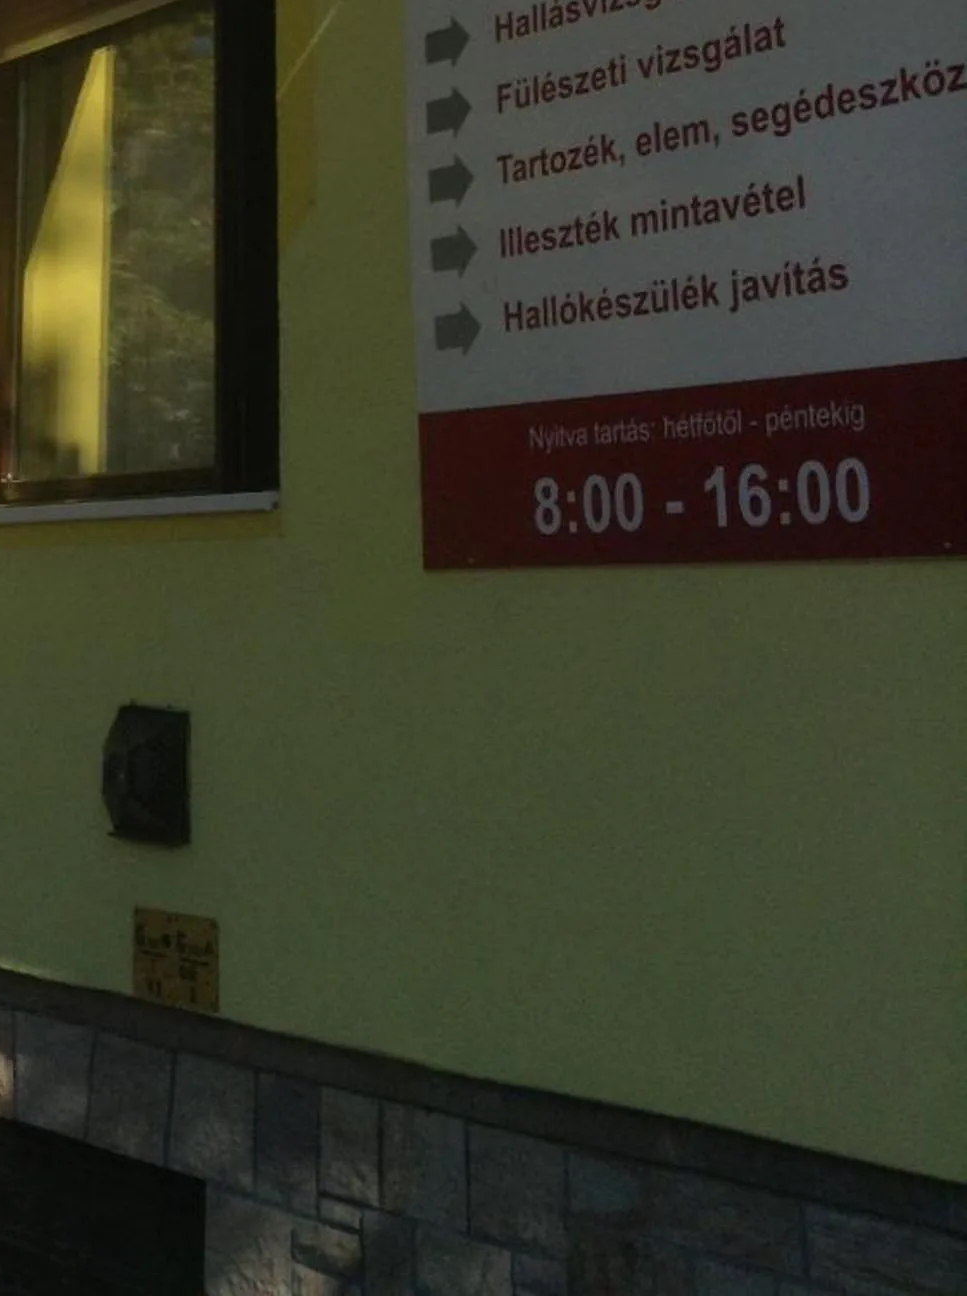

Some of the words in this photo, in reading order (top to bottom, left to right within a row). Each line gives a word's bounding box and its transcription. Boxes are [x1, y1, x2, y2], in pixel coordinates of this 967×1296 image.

[496, 57, 628, 114] Fülészeti
[637, 16, 787, 75] vizsgálat
[496, 134, 626, 185] Tartozék,
[635, 115, 721, 157] elem,
[731, 59, 967, 145] segédeszköz
[499, 211, 621, 258] Illeszték
[630, 174, 807, 238] mintavétel
[503, 275, 719, 333] Hallókészülék
[728, 256, 850, 313] javítás
[529, 424, 588, 455] Nyitva
[765, 400, 865, 437] péntekig
[533, 472, 645, 536] 8:00
[664, 499, 685, 515] -
[703, 457, 871, 528] 16:00
